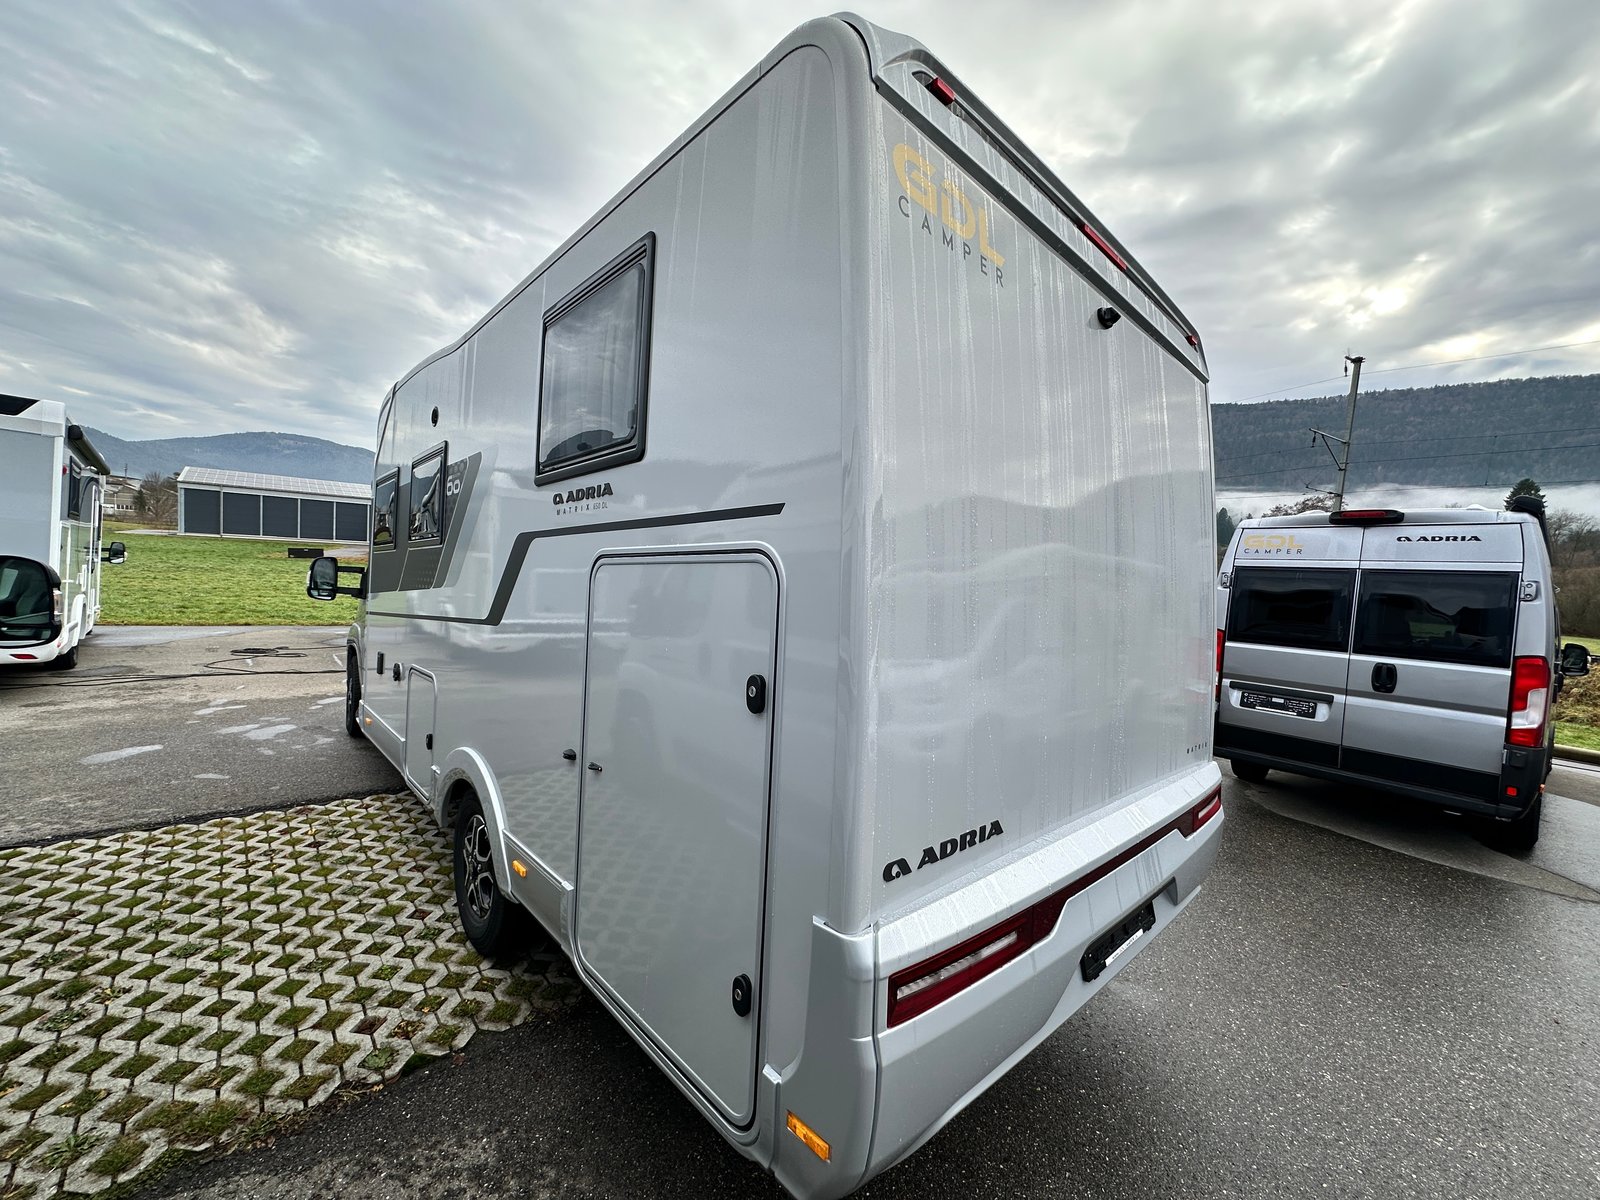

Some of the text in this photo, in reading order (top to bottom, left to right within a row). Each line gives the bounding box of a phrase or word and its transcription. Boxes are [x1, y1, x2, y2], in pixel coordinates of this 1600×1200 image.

[892, 143, 1006, 267] GDL
[898, 195, 1004, 288] CAMPER
[556, 503, 590, 516] MATRIX
[566, 482, 614, 503] ADRIA
[1244, 534, 1304, 548] GDL
[916, 819, 1004, 870] ADRIA
